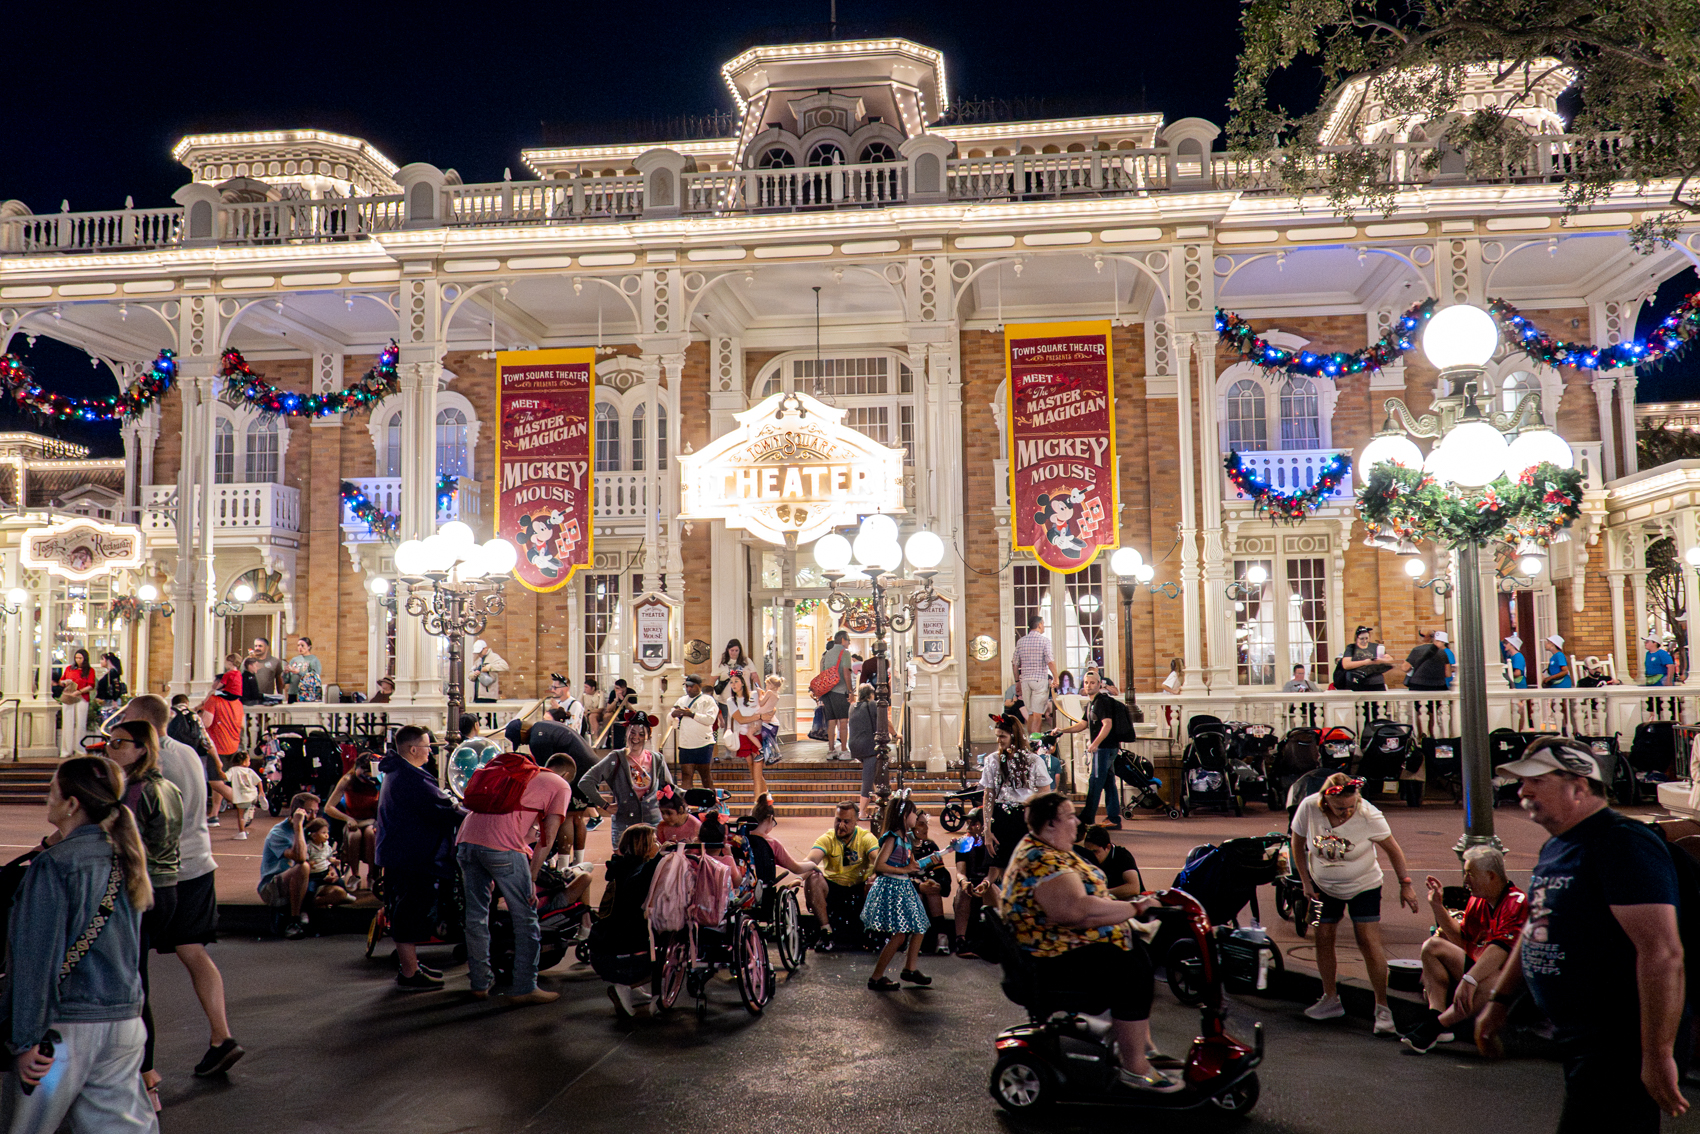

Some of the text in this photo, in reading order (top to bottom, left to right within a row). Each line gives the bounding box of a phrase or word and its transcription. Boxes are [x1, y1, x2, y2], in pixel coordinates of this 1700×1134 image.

[1012, 343, 1106, 360] TOWN SQUARE THEATER
[1045, 353, 1072, 361] PRESENTS
[503, 370, 589, 386] TOWN SQUARE THEATER
[1022, 373, 1053, 386] MEET
[1026, 388, 1081, 414] MASTER
[1032, 386, 1049, 399] The
[511, 399, 540, 410] MEET
[1032, 395, 1106, 428] MAGICIAN
[513, 414, 565, 438] MASTER
[518, 421, 587, 452] MAGICIAN
[746, 431, 838, 460] TOWN SQUARE
[1016, 436, 1109, 472] MICKEY
[502, 461, 588, 493] MICKEY
[710, 466, 873, 499] THEATER
[1031, 463, 1097, 485] MOUSE
[514, 486, 575, 507] MOUSE
[931, 641, 943, 652] 20
